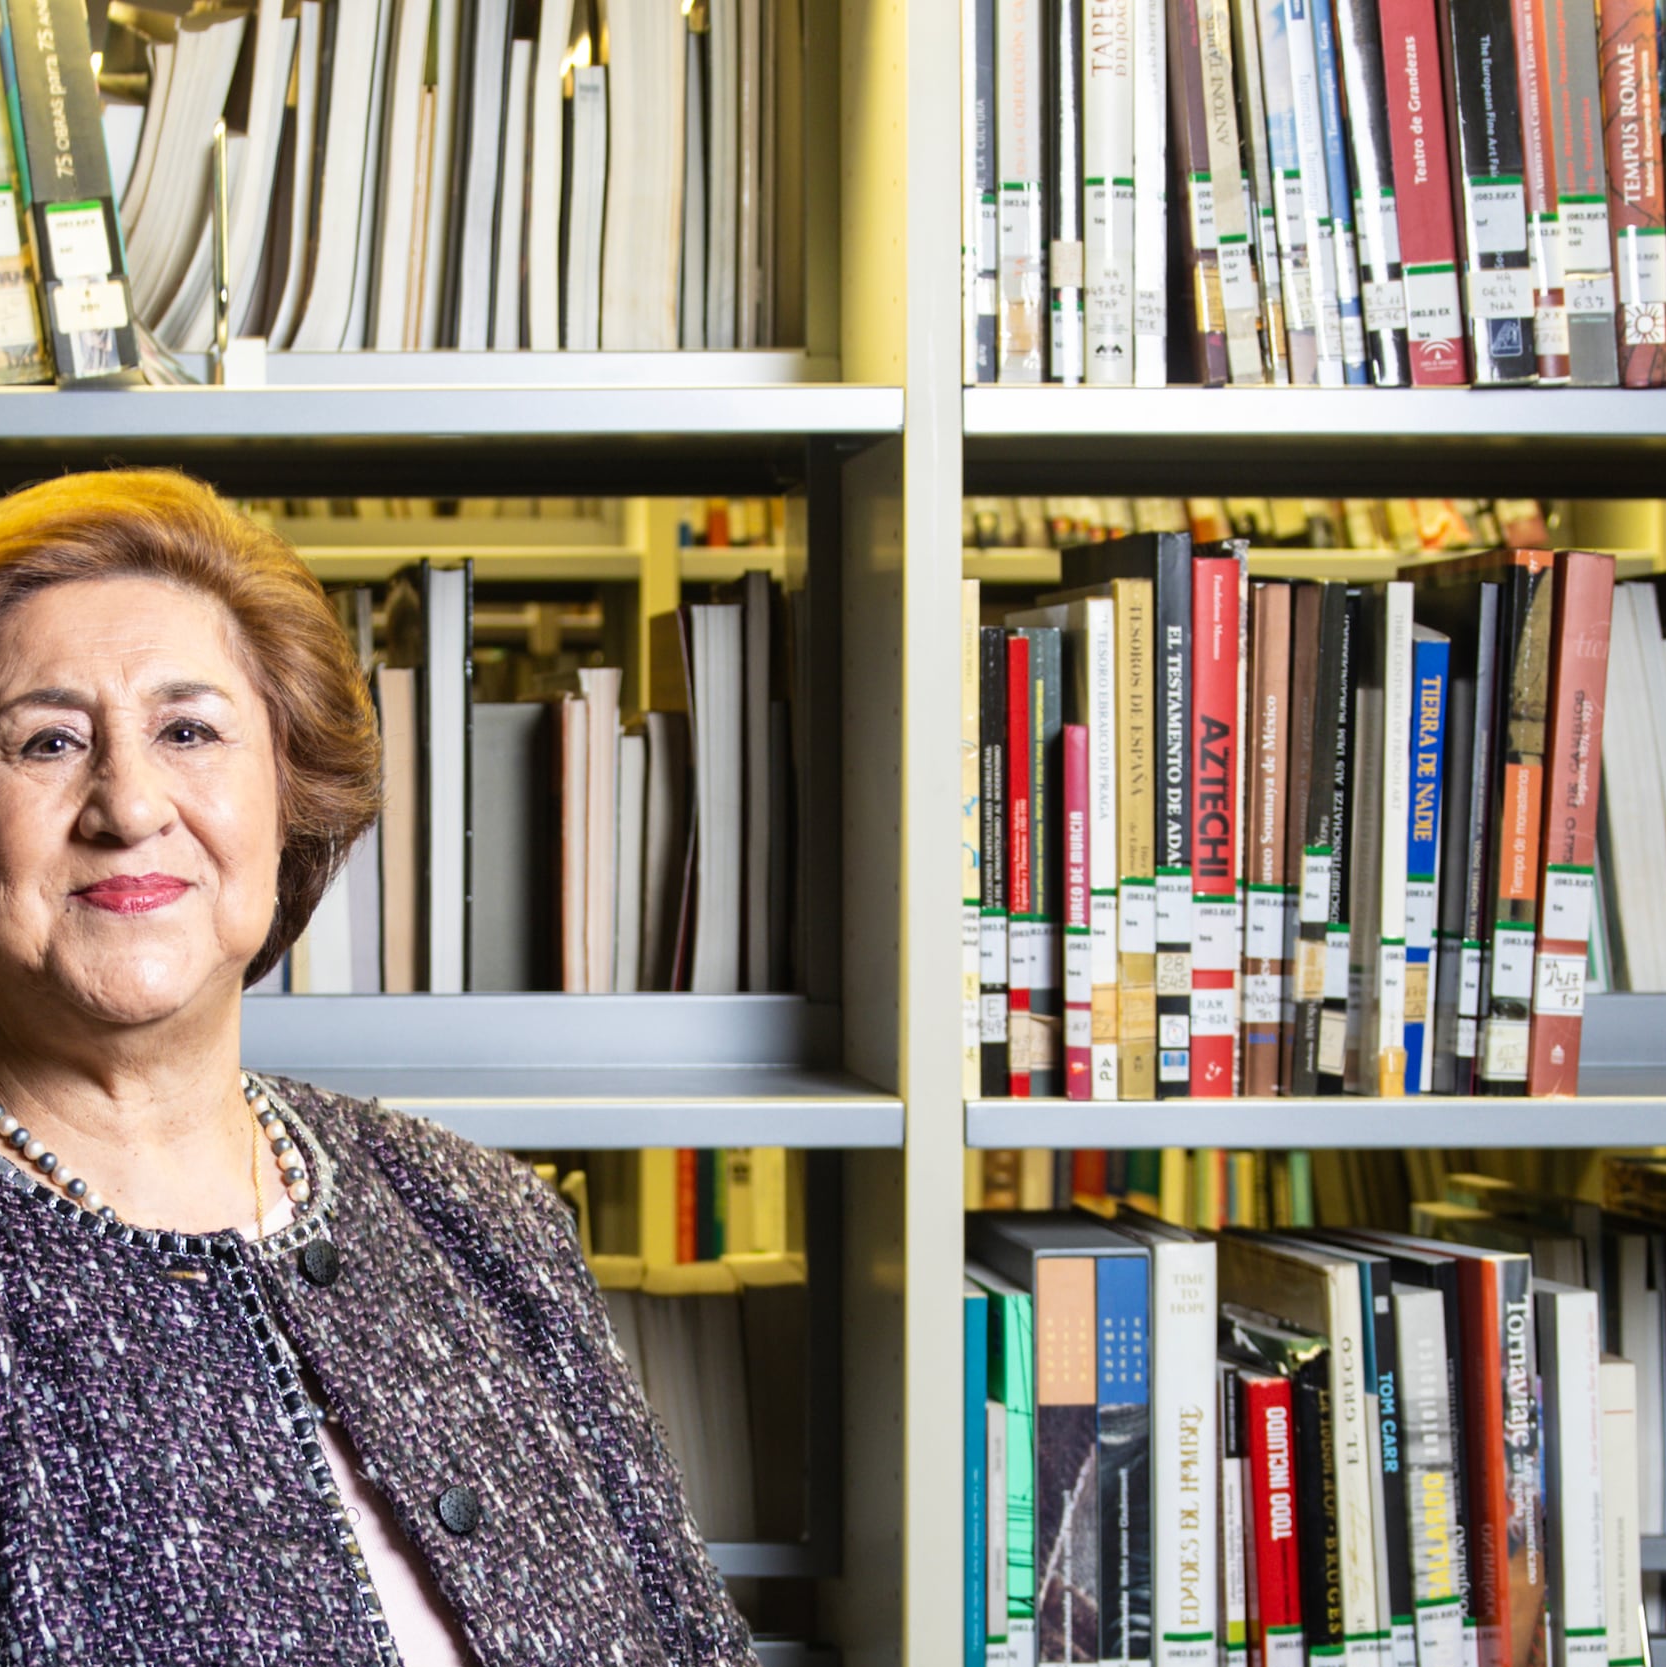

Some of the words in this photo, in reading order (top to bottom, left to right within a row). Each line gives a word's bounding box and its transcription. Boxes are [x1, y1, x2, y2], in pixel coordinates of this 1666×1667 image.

[1478, 35, 1491, 56] The
[1401, 35, 1420, 112] Grandezas
[1479, 57, 1495, 110] European
[1617, 43, 1637, 115] ROMAE
[1409, 116, 1421, 134] de
[1484, 111, 1496, 135] Fine
[1486, 136, 1498, 156] Art
[1411, 138, 1427, 184] Teatro
[1621, 123, 1641, 204] TEMPUS
[1127, 605, 1144, 686] TESOROS
[1166, 625, 1181, 649] EL
[1129, 694, 1144, 718] DE
[1165, 652, 1182, 782] TESTAMENTO
[1261, 695, 1276, 750] México
[1418, 673, 1441, 746] TIERRA
[1262, 754, 1274, 773] de
[1416, 752, 1436, 777] DE
[1167, 787, 1182, 814] DE
[1199, 715, 1229, 876] AZTECHI
[1412, 781, 1435, 841] NADIE
[1512, 837, 1525, 850] de
[1510, 854, 1527, 893] Tiempo
[1341, 1336, 1355, 1421] GRECO
[1378, 1371, 1396, 1412] TOM
[1505, 1298, 1536, 1447] Tornaviaje
[1267, 1406, 1289, 1488] INCLUIDO
[1345, 1432, 1358, 1464] EL
[1380, 1420, 1398, 1471] CARR
[1270, 1494, 1292, 1539] TODO
